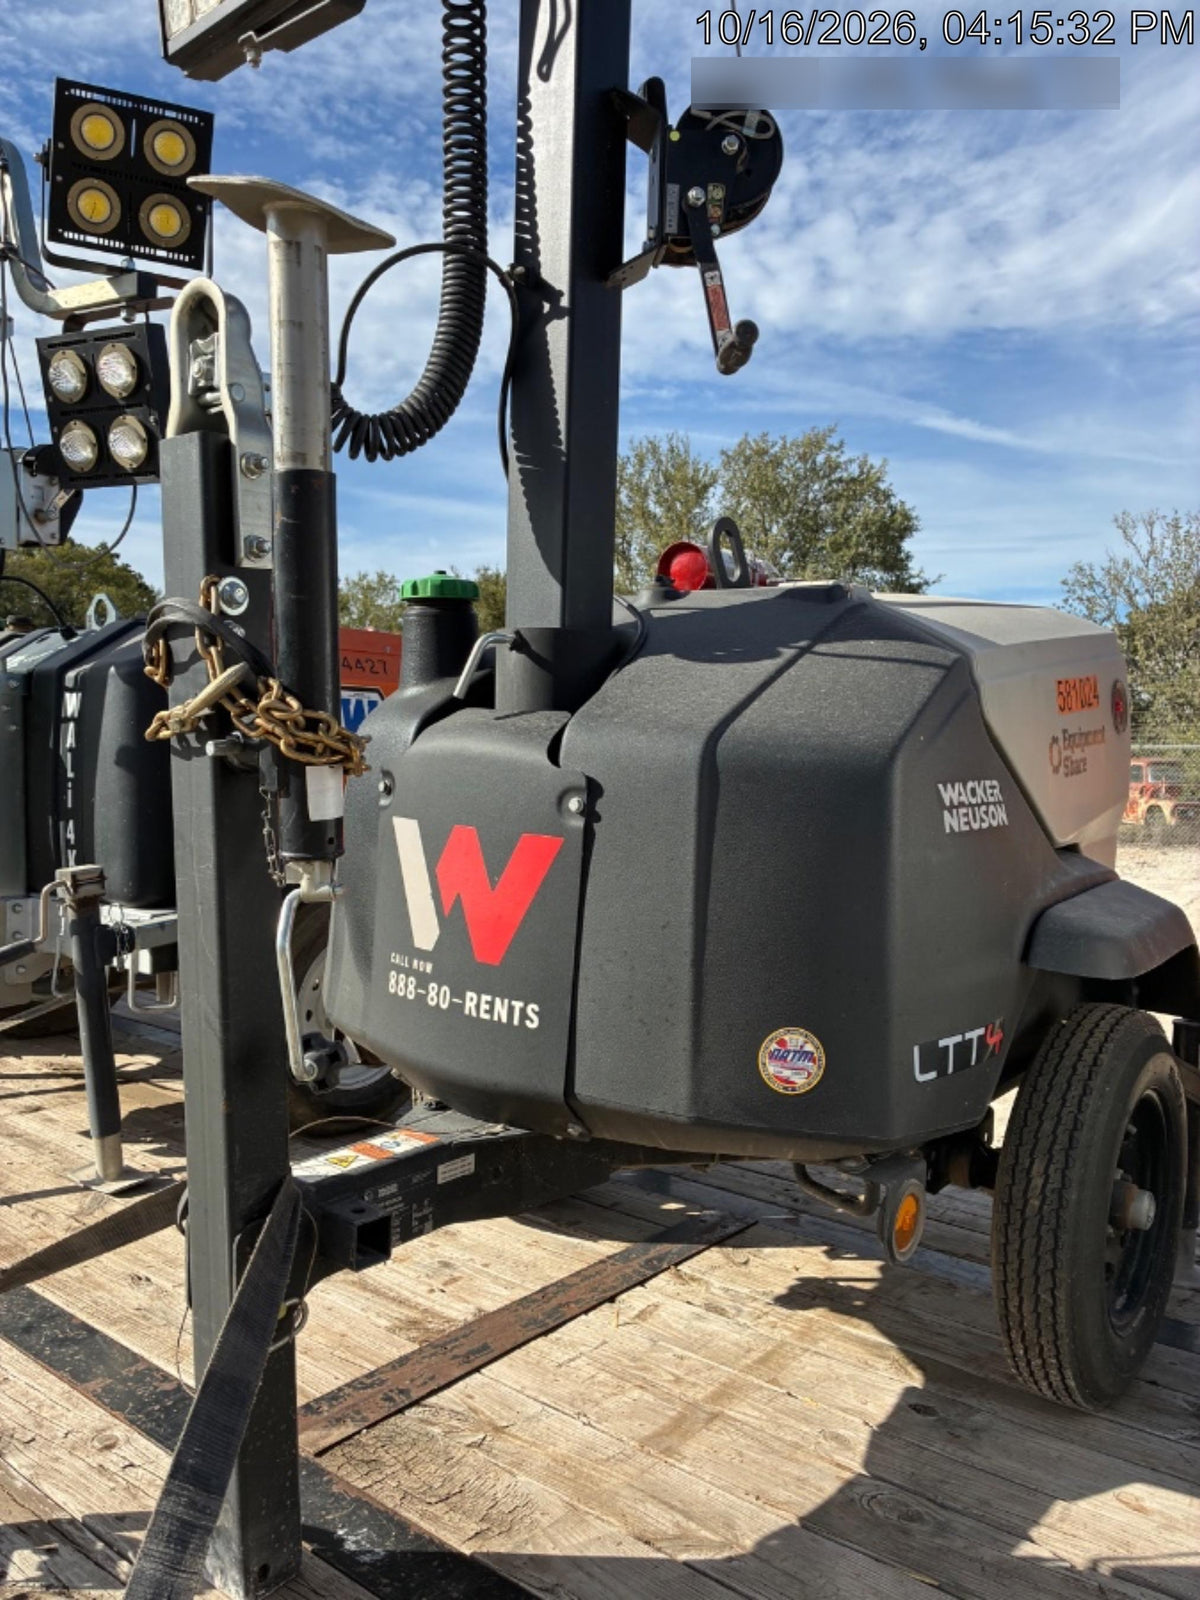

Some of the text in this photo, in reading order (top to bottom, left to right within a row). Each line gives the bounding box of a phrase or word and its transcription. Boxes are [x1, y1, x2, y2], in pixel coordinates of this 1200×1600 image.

[937, 780, 1003, 806] WACKER
[943, 805, 1008, 833] NEUSON
[390, 952, 433, 974] CALL NOW
[388, 971, 540, 1029] 888-80-RENTS
[913, 1022, 1003, 1082] LTT4
